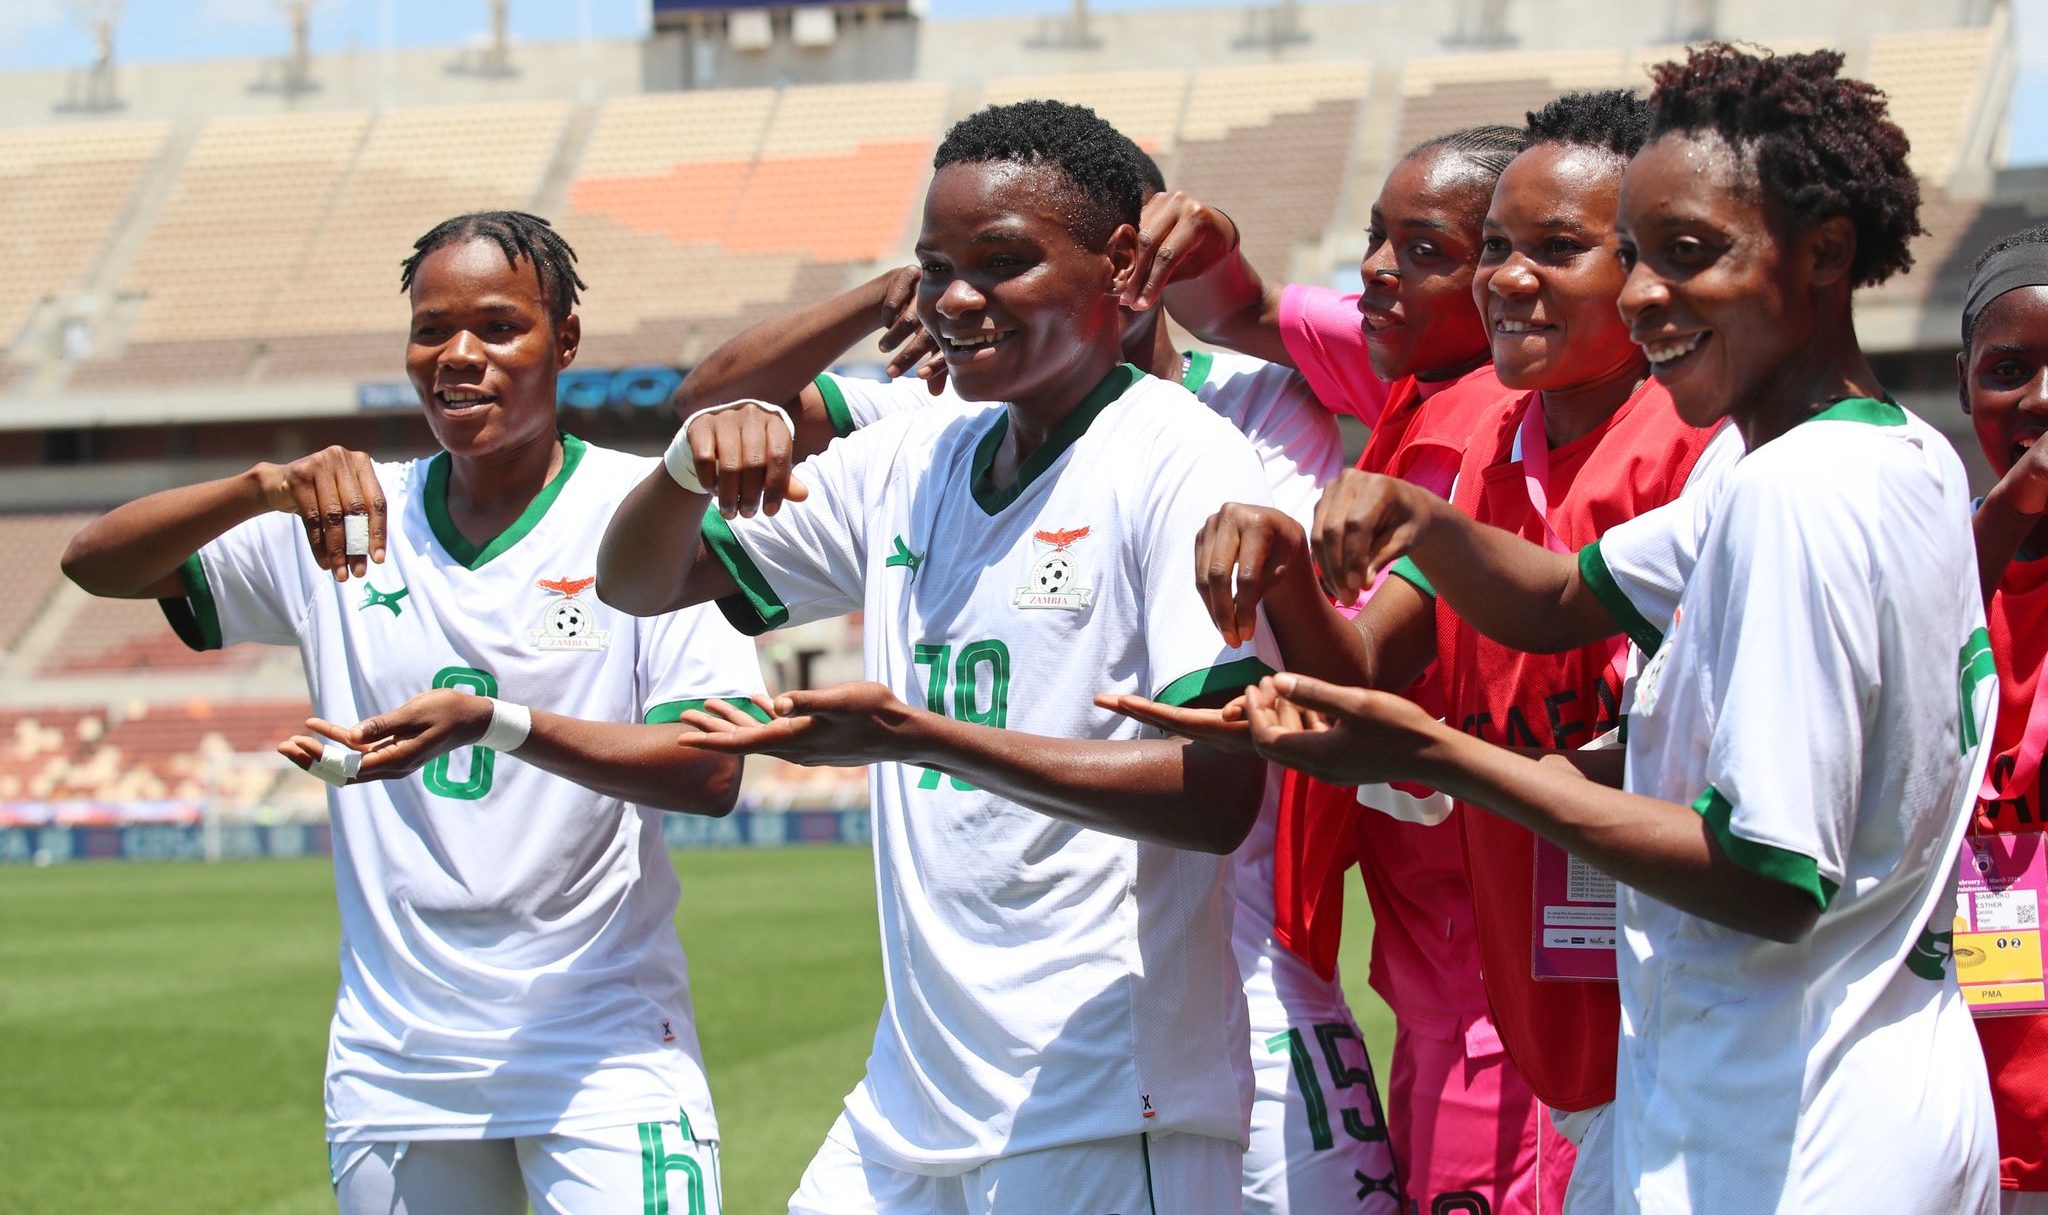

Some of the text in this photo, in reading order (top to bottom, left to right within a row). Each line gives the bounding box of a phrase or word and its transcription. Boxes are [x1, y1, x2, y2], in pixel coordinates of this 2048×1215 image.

[1030, 597, 1067, 605] ZAMBIA
[1982, 990, 2002, 998] PMA
[1265, 1023, 1386, 1151] 15
